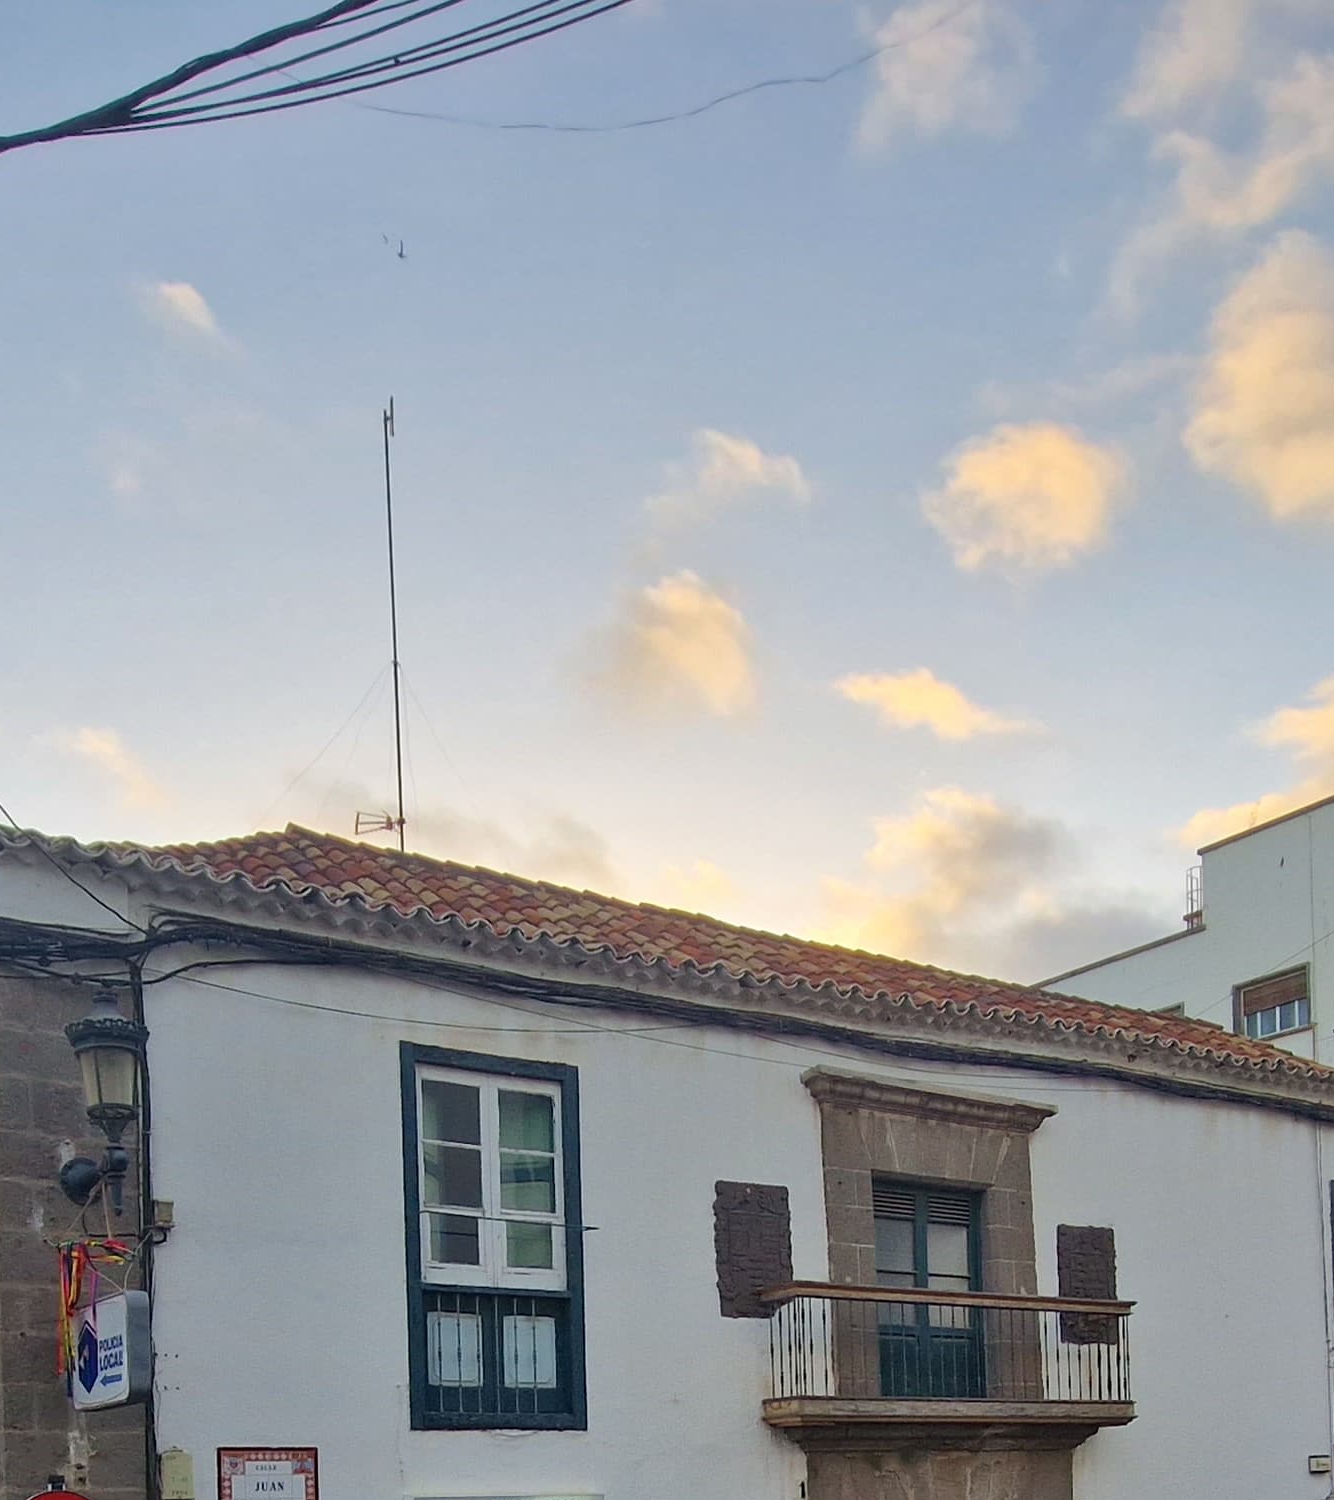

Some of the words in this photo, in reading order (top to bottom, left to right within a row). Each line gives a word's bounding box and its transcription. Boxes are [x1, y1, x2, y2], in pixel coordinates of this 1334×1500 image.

[99, 1333, 124, 1352] POLICIA
[99, 1351, 124, 1372] LOCAL
[255, 1481, 284, 1492] JUAN
